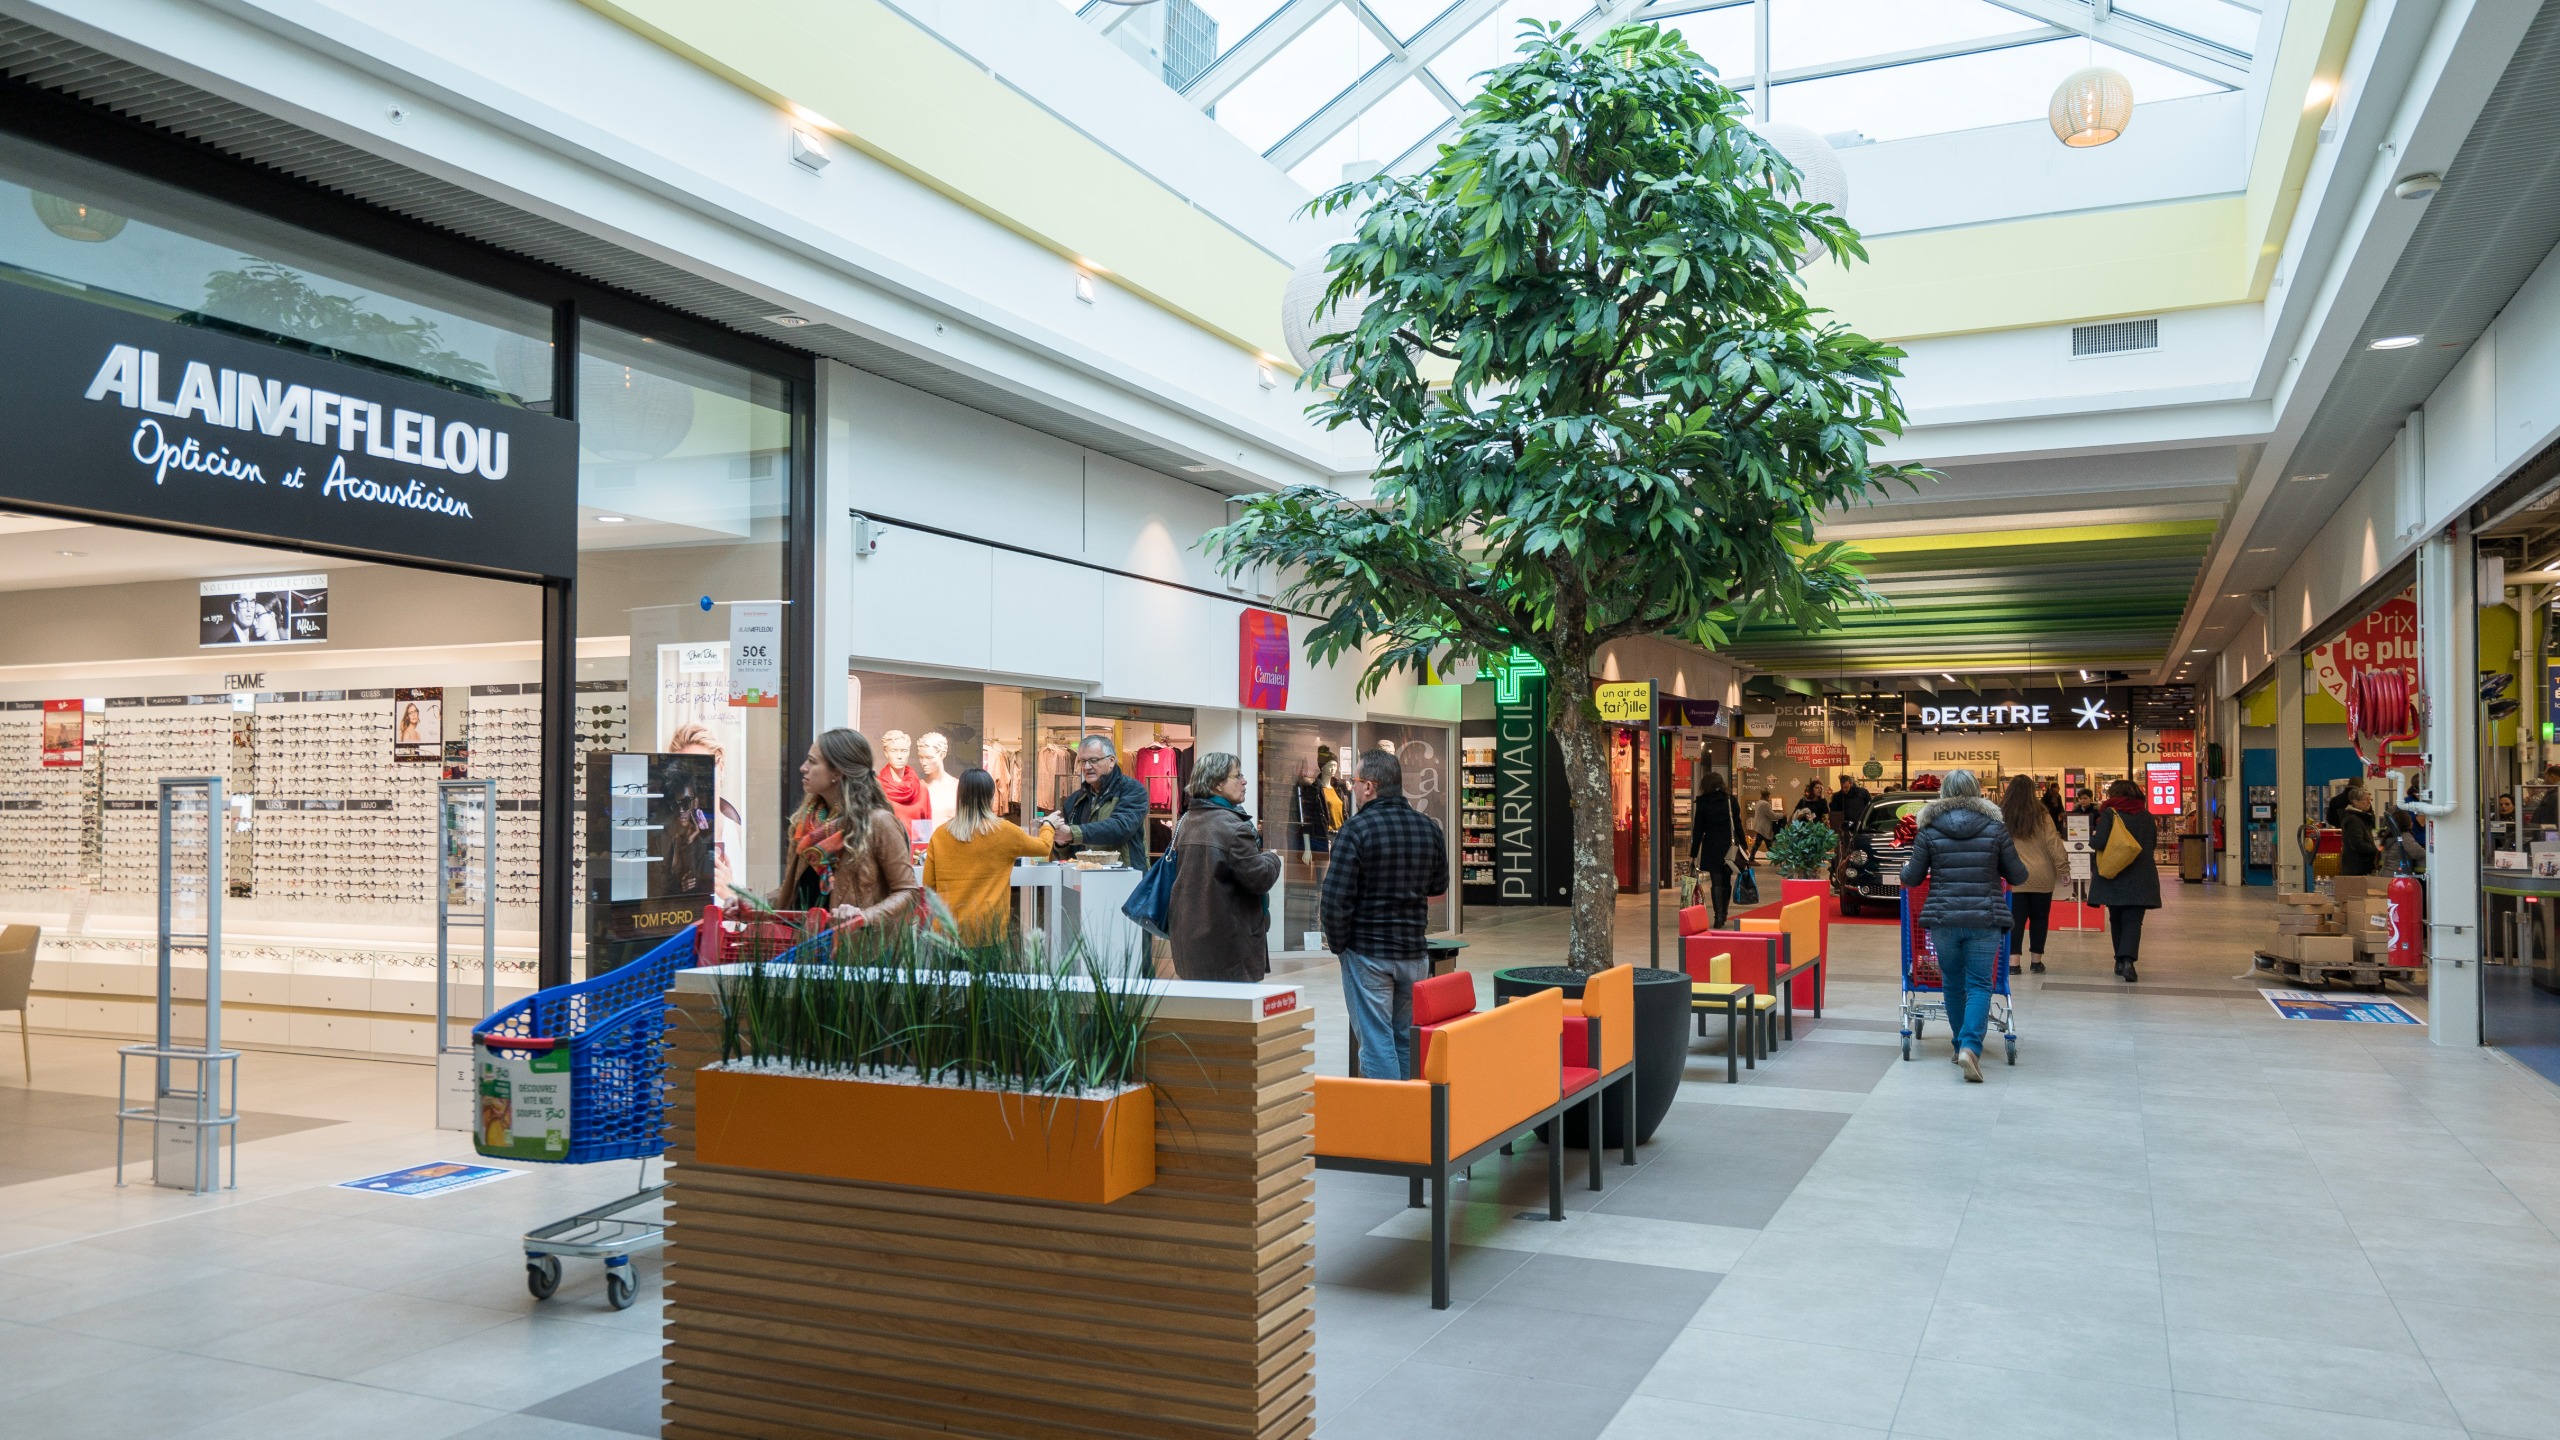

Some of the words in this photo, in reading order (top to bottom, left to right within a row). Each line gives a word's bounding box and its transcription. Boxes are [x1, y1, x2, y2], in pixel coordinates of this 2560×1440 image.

[131, 417, 267, 486] Opticien
[281, 466, 307, 489] et
[322, 454, 474, 519] Acousticien
[259, 577, 326, 589] COLLECTION
[2366, 610, 2415, 635] Prix
[2345, 637, 2370, 661] le
[2376, 635, 2418, 665] plu
[736, 658, 773, 666] OFFERTS
[225, 673, 266, 691] FEMME
[360, 690, 381, 699] GUESS
[1602, 690, 1615, 698] un
[1617, 688, 1631, 697] air
[1633, 688, 1647, 697] de
[1921, 704, 2050, 726] DECITRE
[1812, 757, 1848, 765] DECITRE
[265, 801, 288, 810] VERSACE
[632, 912, 659, 929] TOM
[660, 910, 693, 926] FORD
[523, 1096, 537, 1105] VITE
[539, 1096, 553, 1105] NOS
[516, 1109, 542, 1118] SOUPES
